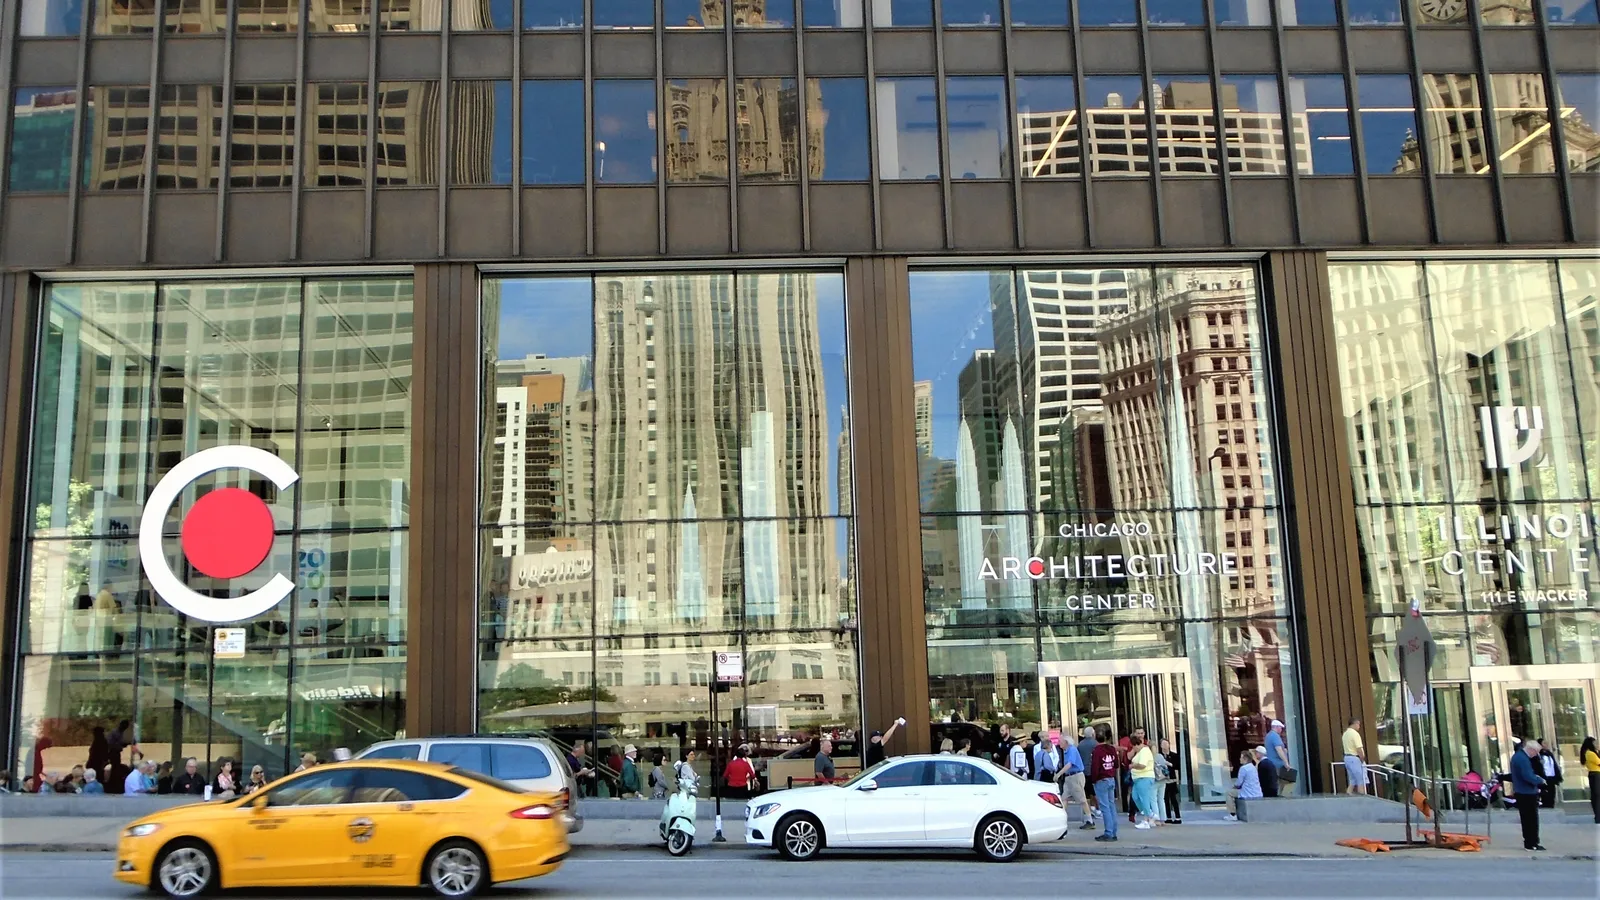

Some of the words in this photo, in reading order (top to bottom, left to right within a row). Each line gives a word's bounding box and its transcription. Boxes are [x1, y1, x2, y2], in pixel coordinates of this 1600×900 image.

[1059, 522, 1151, 537] CHICAGO
[1438, 513, 1600, 540] ILLINOI
[977, 552, 1239, 580] ARCHITECTURE
[1066, 593, 1156, 610] CENTER
[1480, 592, 1501, 603] 111
[1508, 590, 1516, 603] E
[1521, 589, 1588, 602] WACKER
